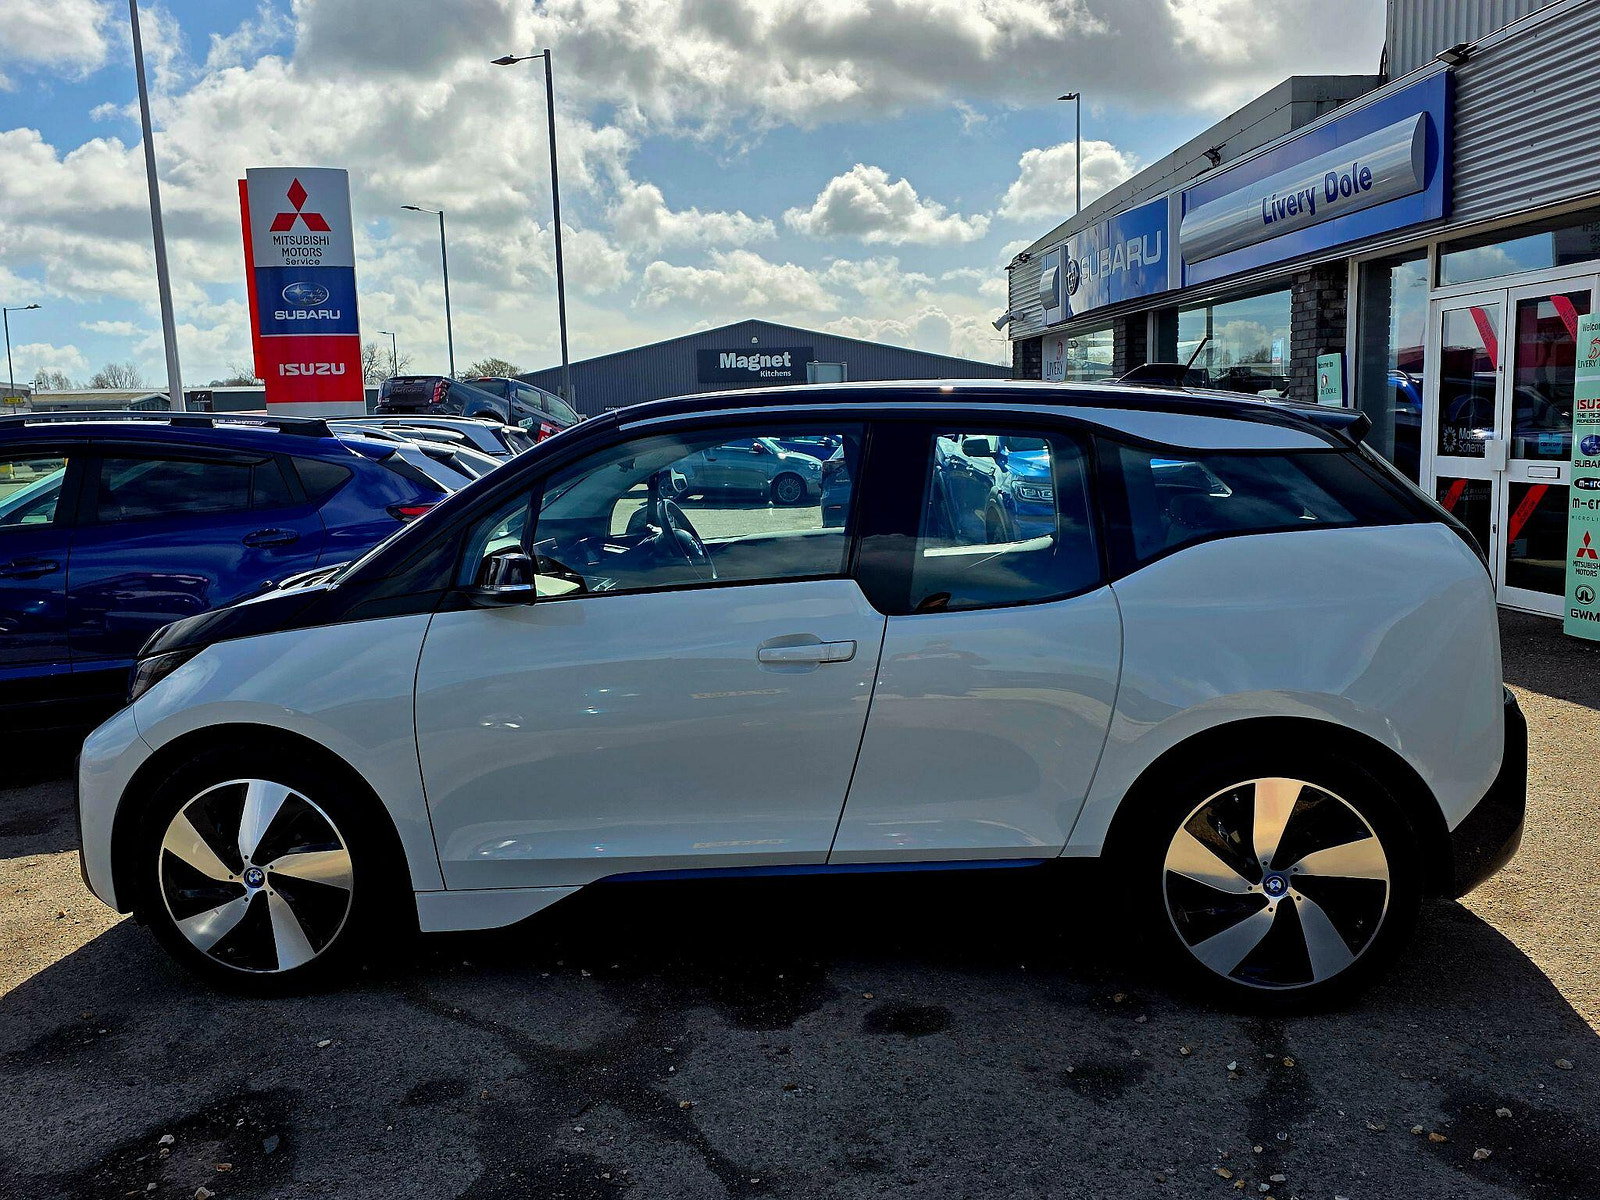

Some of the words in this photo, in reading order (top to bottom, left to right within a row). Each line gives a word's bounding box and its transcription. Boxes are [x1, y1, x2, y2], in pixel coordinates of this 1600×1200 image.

[1261, 186, 1316, 225] Livery
[1324, 162, 1373, 203] Dole
[273, 235, 330, 246] MITSUBISHI
[281, 247, 322, 257] MOTORS
[1081, 230, 1162, 282] SUBARU
[285, 257, 320, 266] Service
[274, 309, 341, 320] SUBARU
[719, 351, 792, 371] Magnet
[278, 362, 346, 377] ISUZU
[1575, 568, 1598, 577] MOTORS
[1570, 608, 1600, 622] GWM
